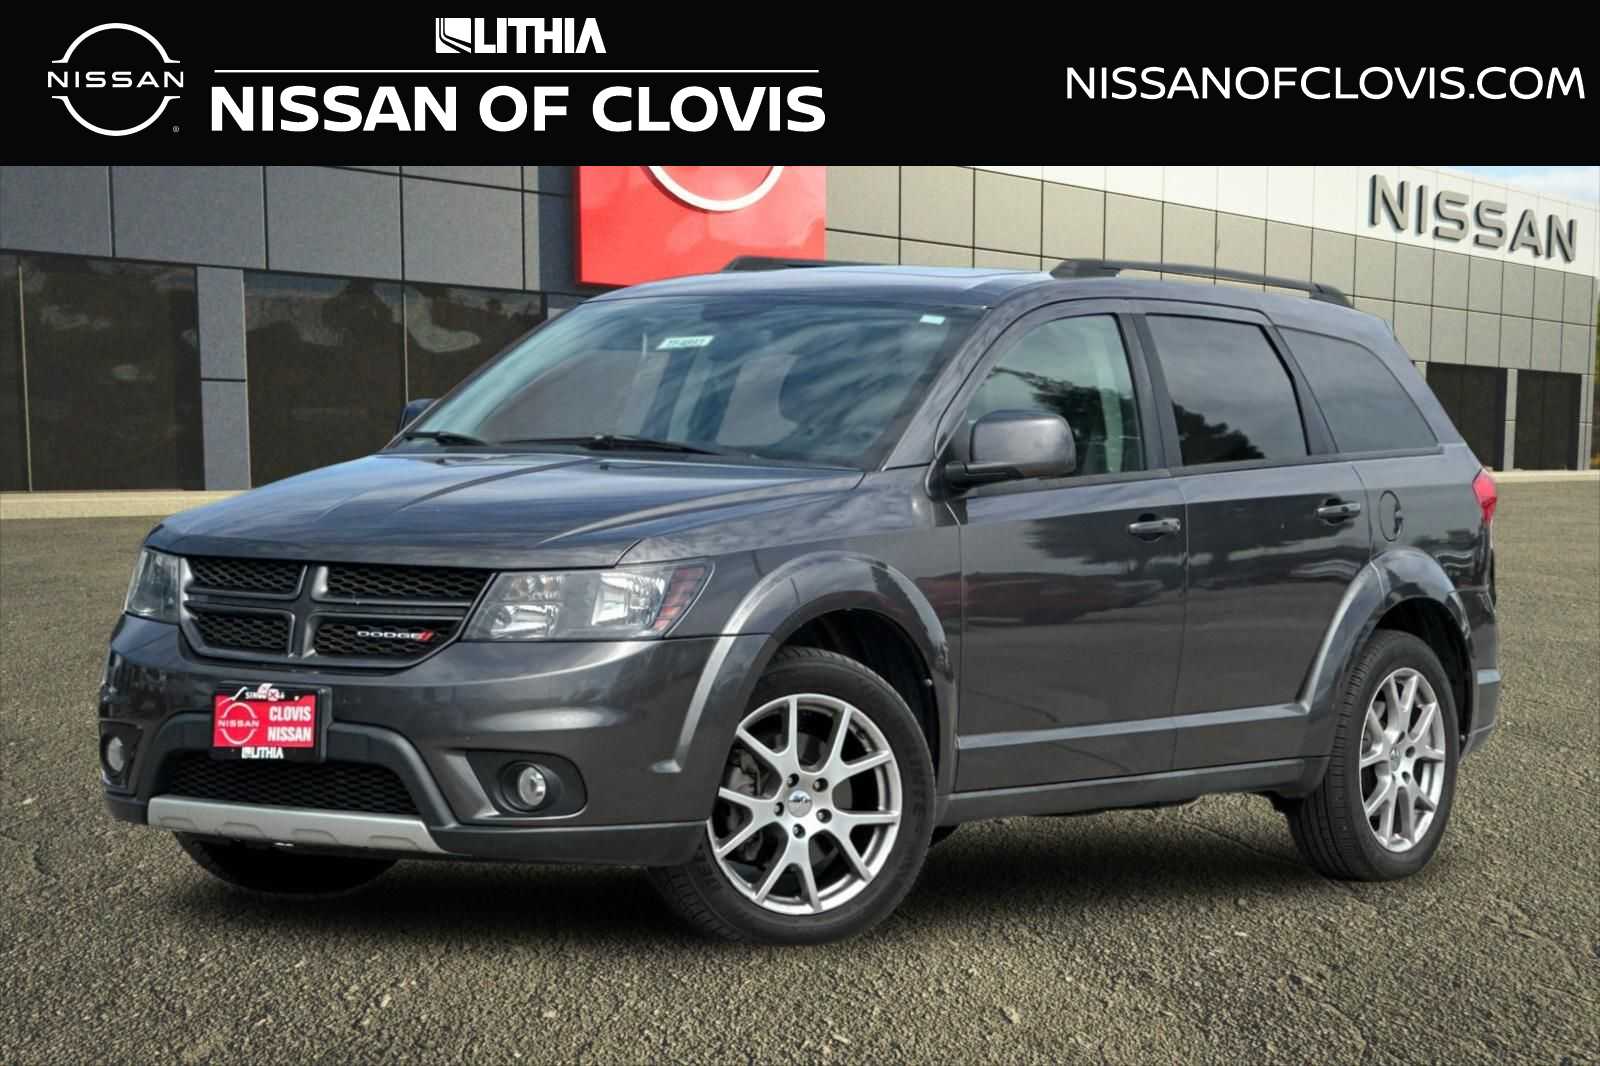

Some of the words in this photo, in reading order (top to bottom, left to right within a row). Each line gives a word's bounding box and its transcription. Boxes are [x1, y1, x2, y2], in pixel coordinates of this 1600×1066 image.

[1368, 174, 1578, 263] NISSAN
[357, 631, 420, 639] DODGE
[268, 706, 312, 722] CLOVIS
[267, 727, 312, 742] NISSAN
[252, 746, 284, 759] LITHIA
